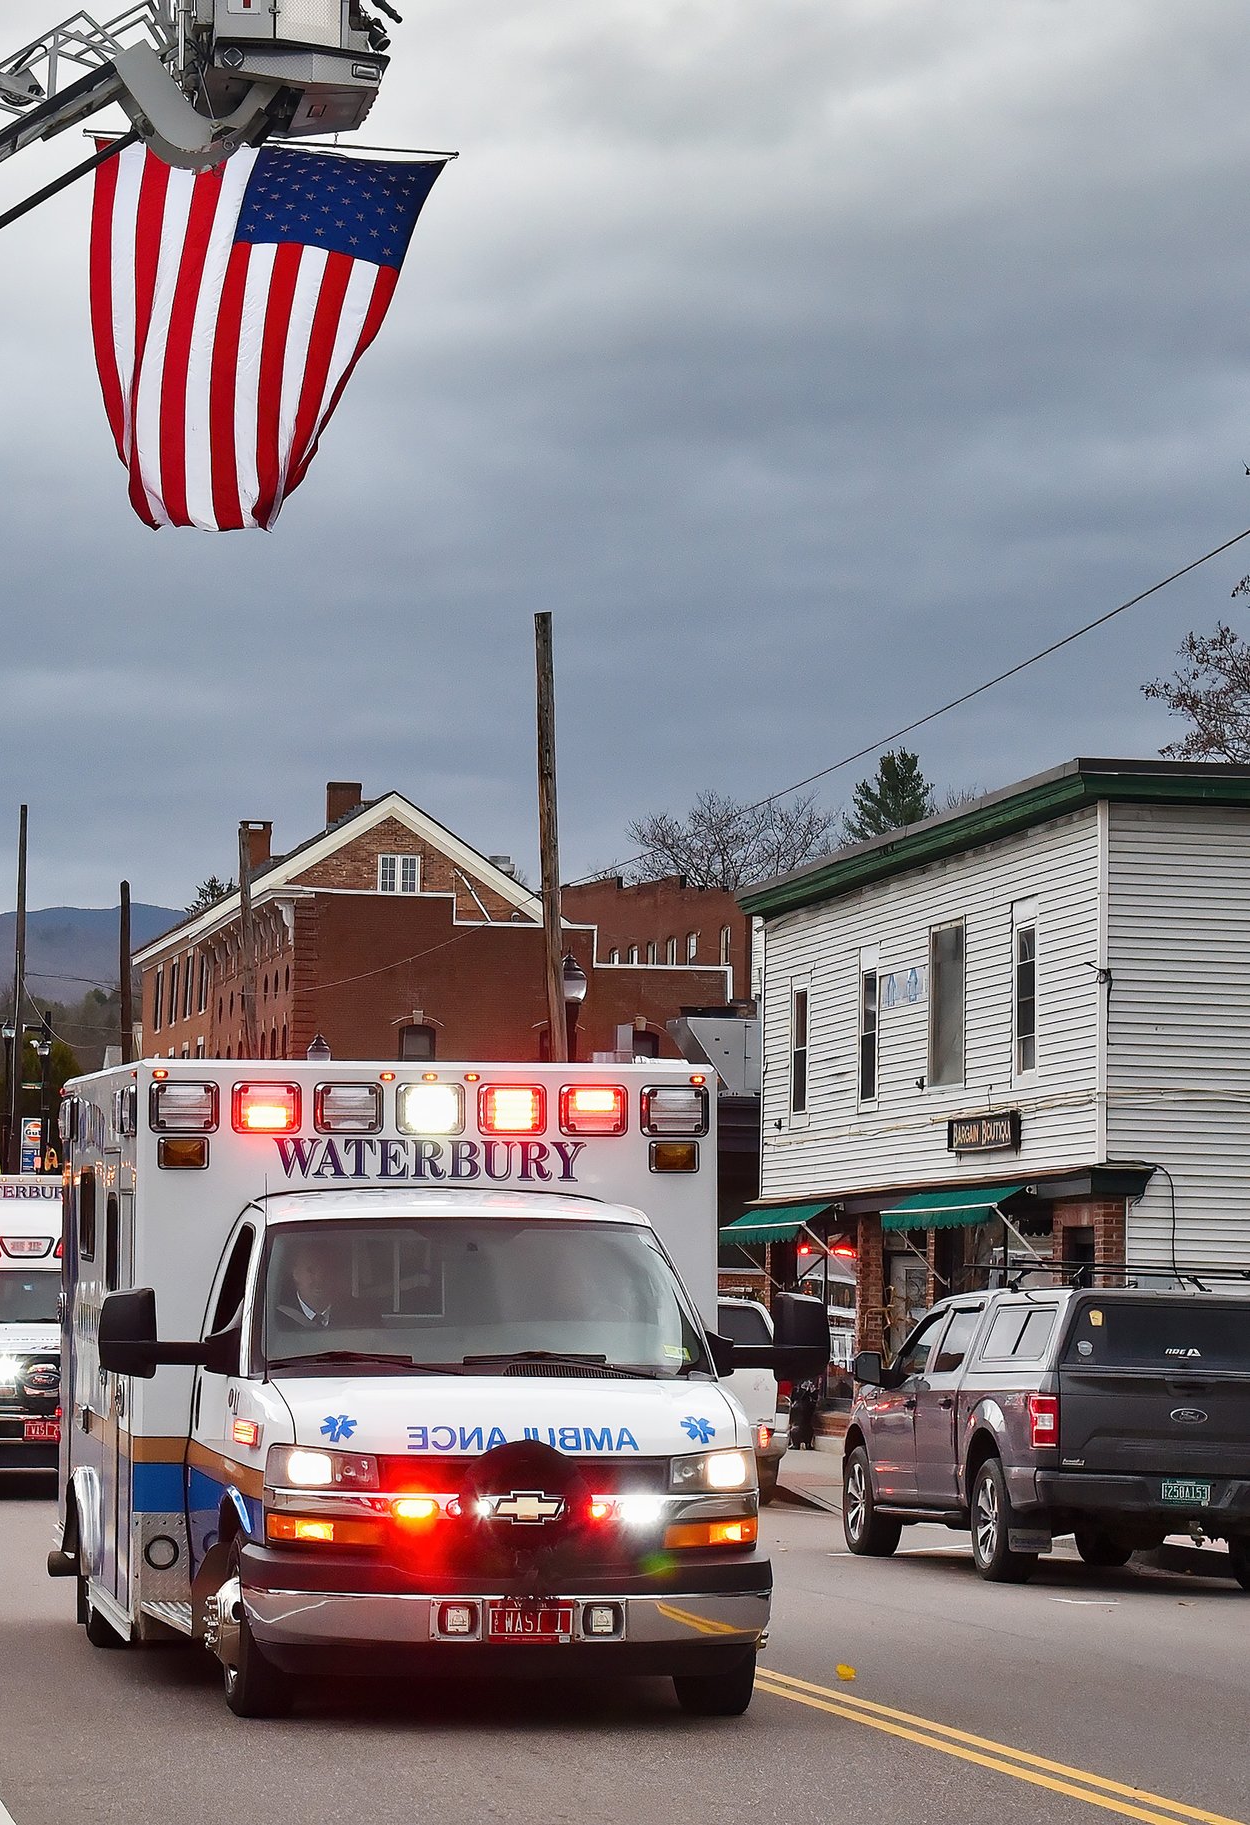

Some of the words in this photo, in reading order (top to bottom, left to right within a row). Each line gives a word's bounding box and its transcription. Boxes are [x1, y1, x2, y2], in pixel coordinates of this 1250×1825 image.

[953, 1123, 979, 1148] BARGAIN
[981, 1120, 1011, 1145] BOUTIQU
[272, 1137, 587, 1182] WATERBURY
